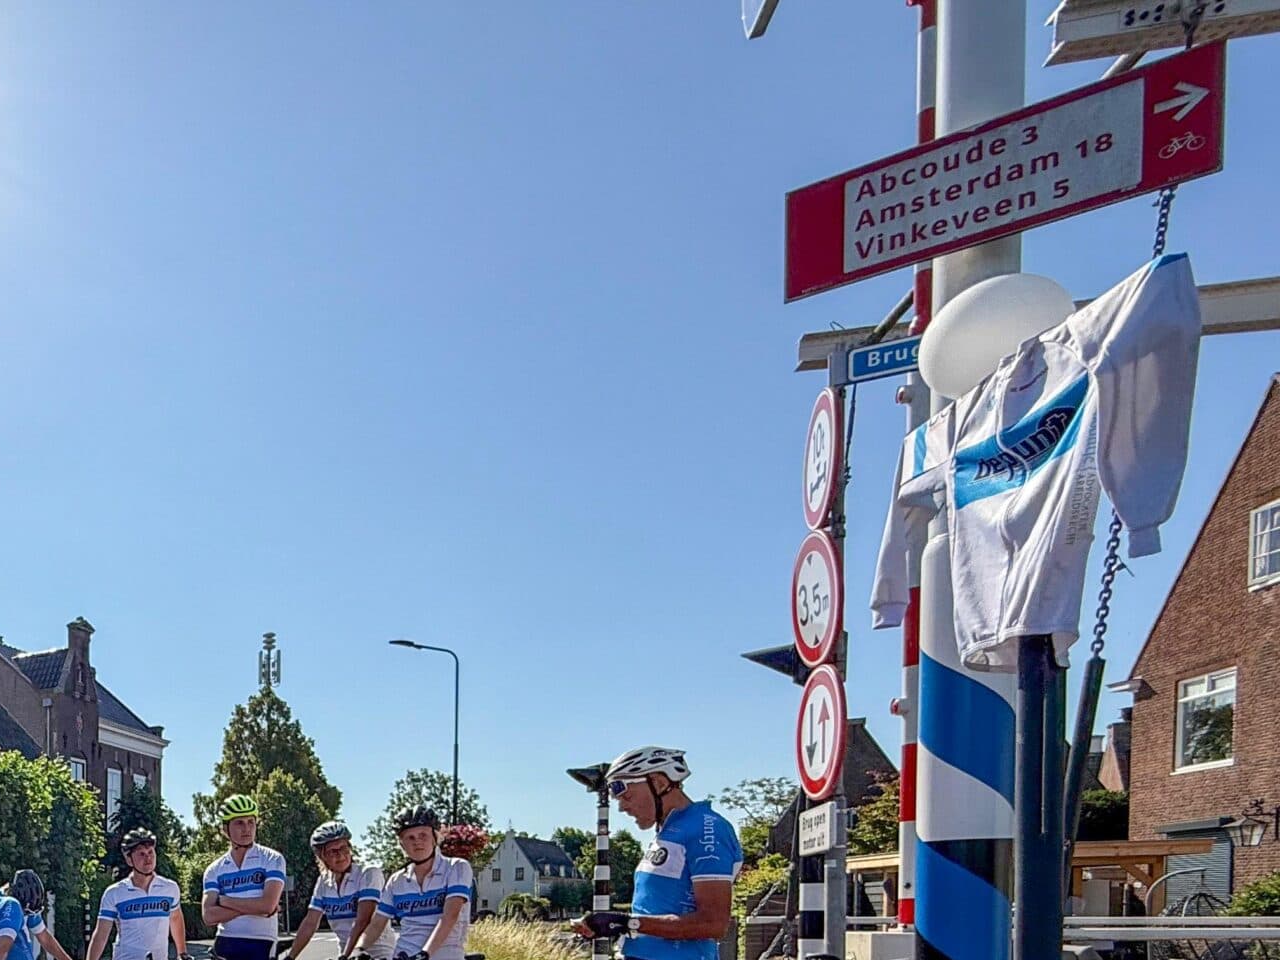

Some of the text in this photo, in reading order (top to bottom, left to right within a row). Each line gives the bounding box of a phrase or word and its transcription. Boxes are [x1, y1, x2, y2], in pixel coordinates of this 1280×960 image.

[855, 125, 1039, 202] Abcoude 3
[855, 132, 1114, 232] Amsterdam 18
[854, 178, 1070, 260] Vinkeveen 5
